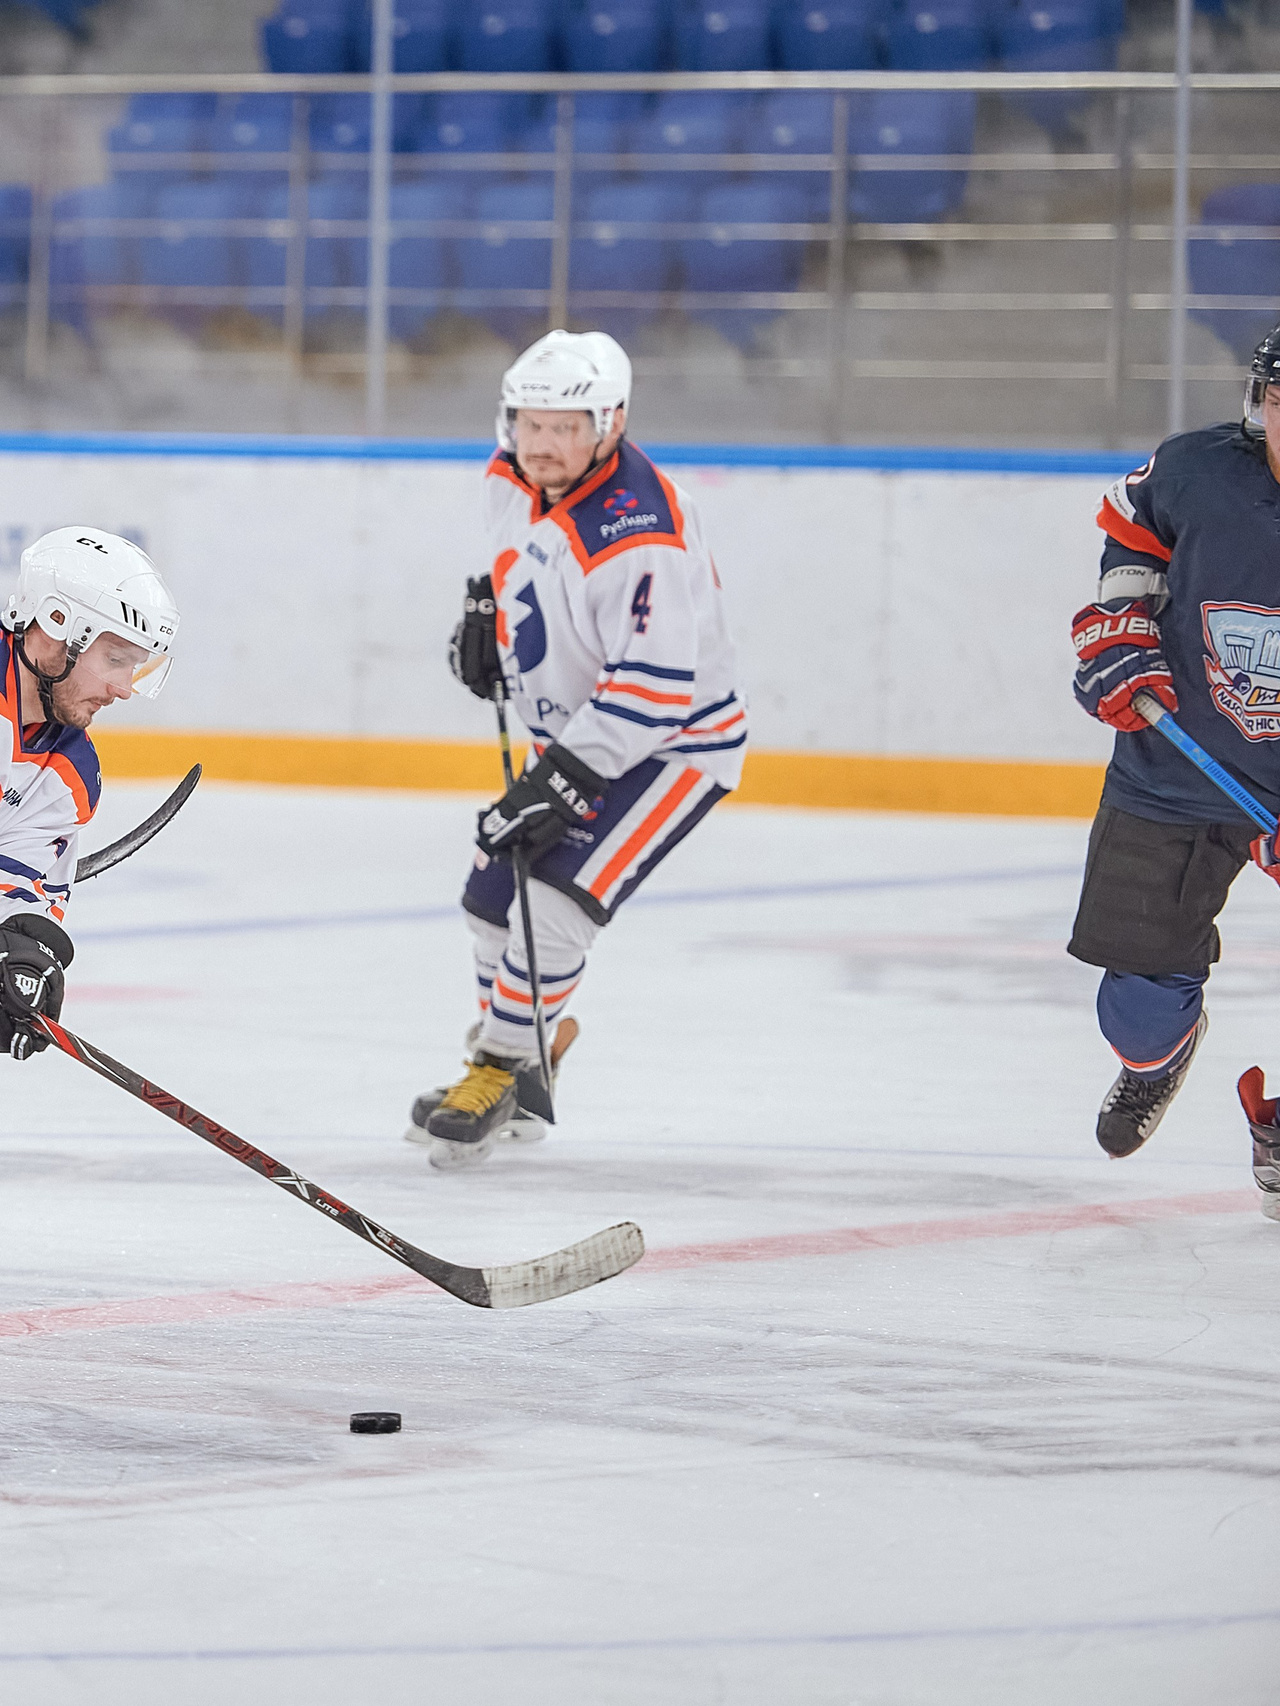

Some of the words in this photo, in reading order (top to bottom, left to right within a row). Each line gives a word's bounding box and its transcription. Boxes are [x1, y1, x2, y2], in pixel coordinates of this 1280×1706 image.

[1106, 567, 1146, 578] ASTON
[630, 571, 654, 634] 4
[1218, 690, 1254, 732] NASCIR
[141, 1079, 281, 1178] VAPOR
